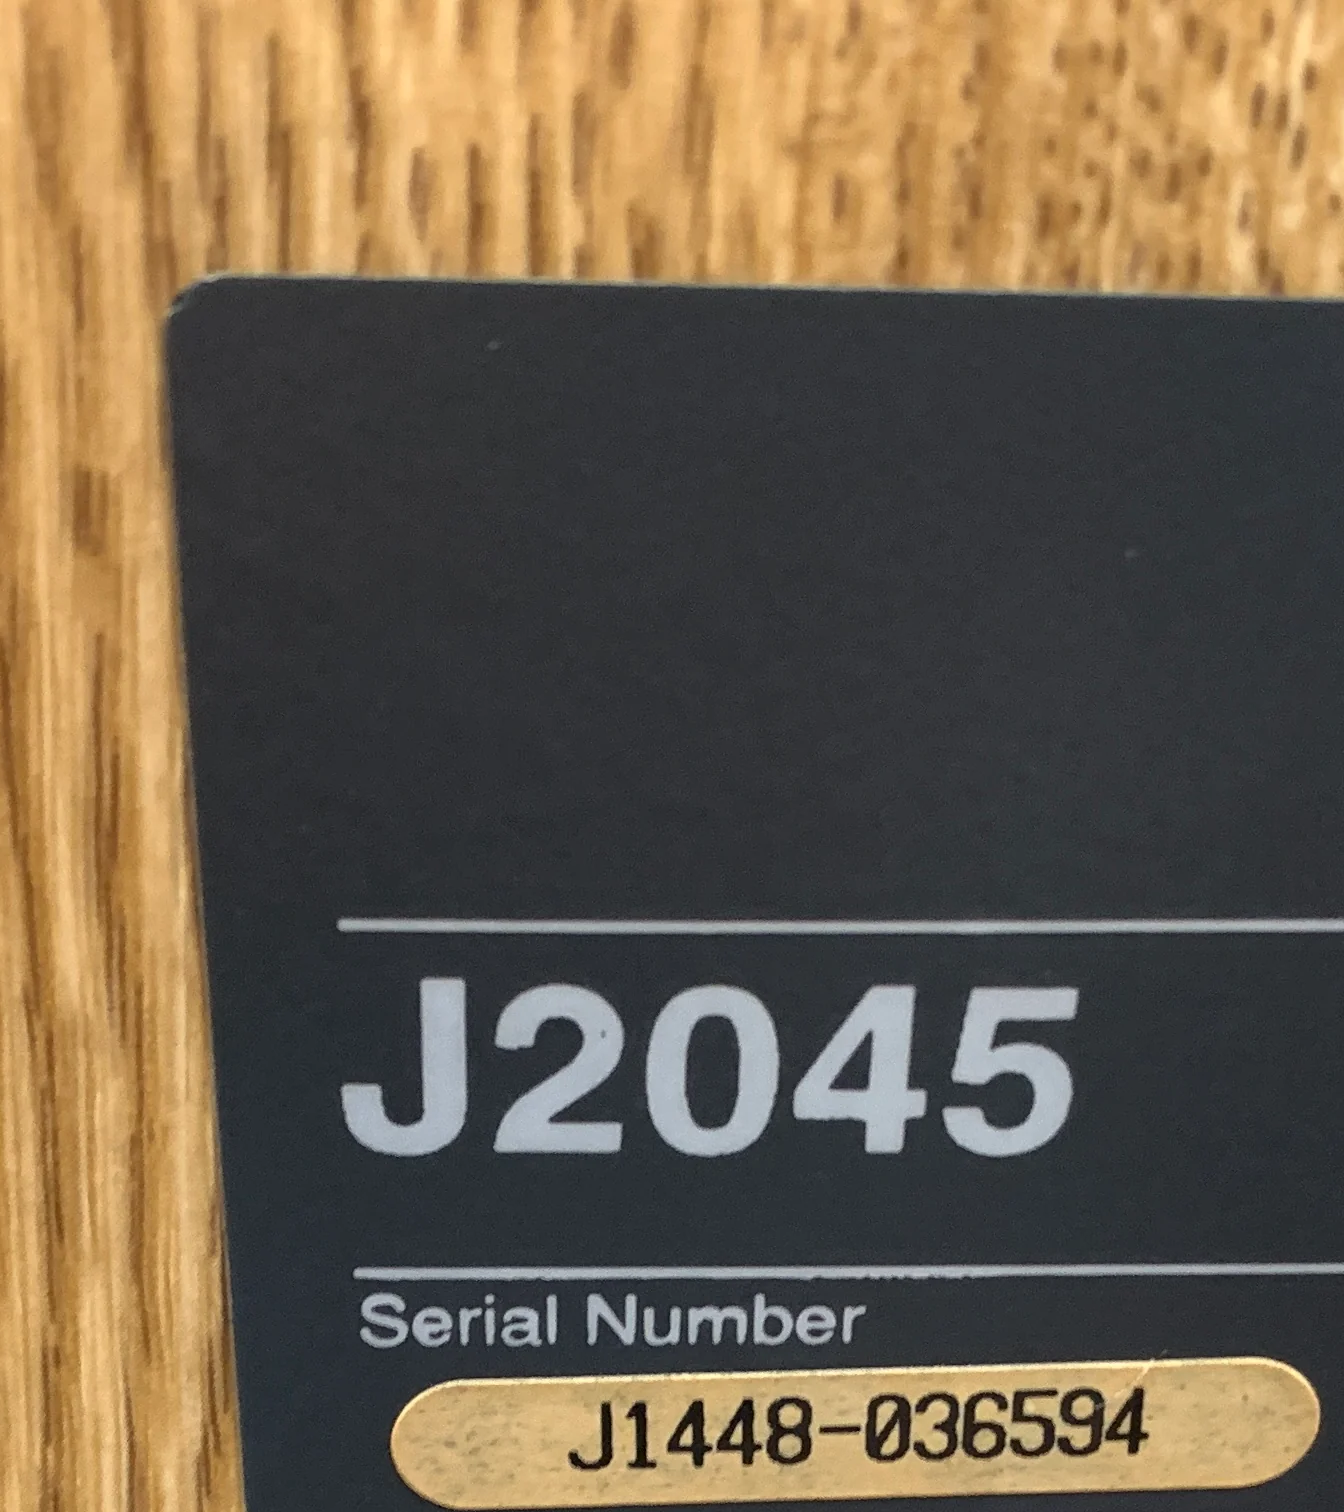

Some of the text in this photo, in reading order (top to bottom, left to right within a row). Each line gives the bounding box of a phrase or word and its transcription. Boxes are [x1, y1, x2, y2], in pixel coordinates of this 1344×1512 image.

[340, 976, 1080, 1158] J2045
[358, 1291, 867, 1348] Serial Number
[567, 1386, 1151, 1471] J1448-036594
